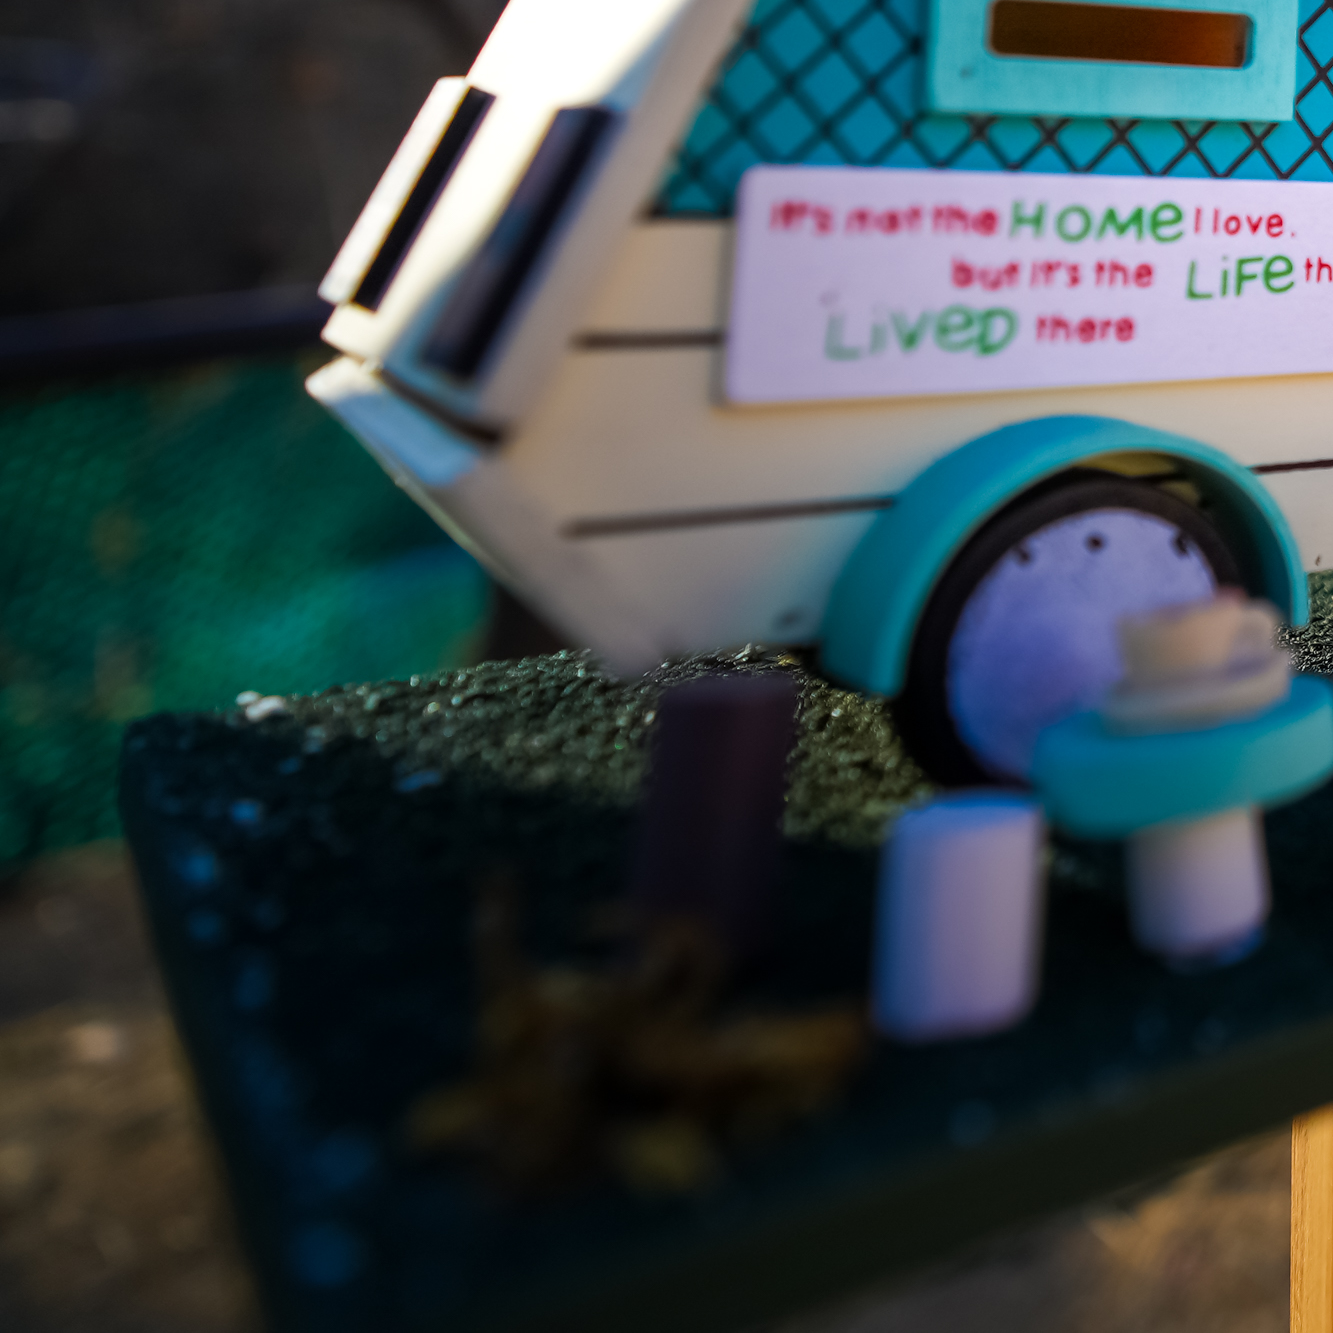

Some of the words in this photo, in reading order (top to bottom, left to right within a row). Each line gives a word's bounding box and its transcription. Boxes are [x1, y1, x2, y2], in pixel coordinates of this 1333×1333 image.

[845, 206, 923, 237] not
[931, 204, 999, 237] the
[1212, 208, 1297, 238] love.
[951, 256, 1022, 292] but
[1094, 260, 1155, 289] the
[1035, 313, 1136, 344] there
